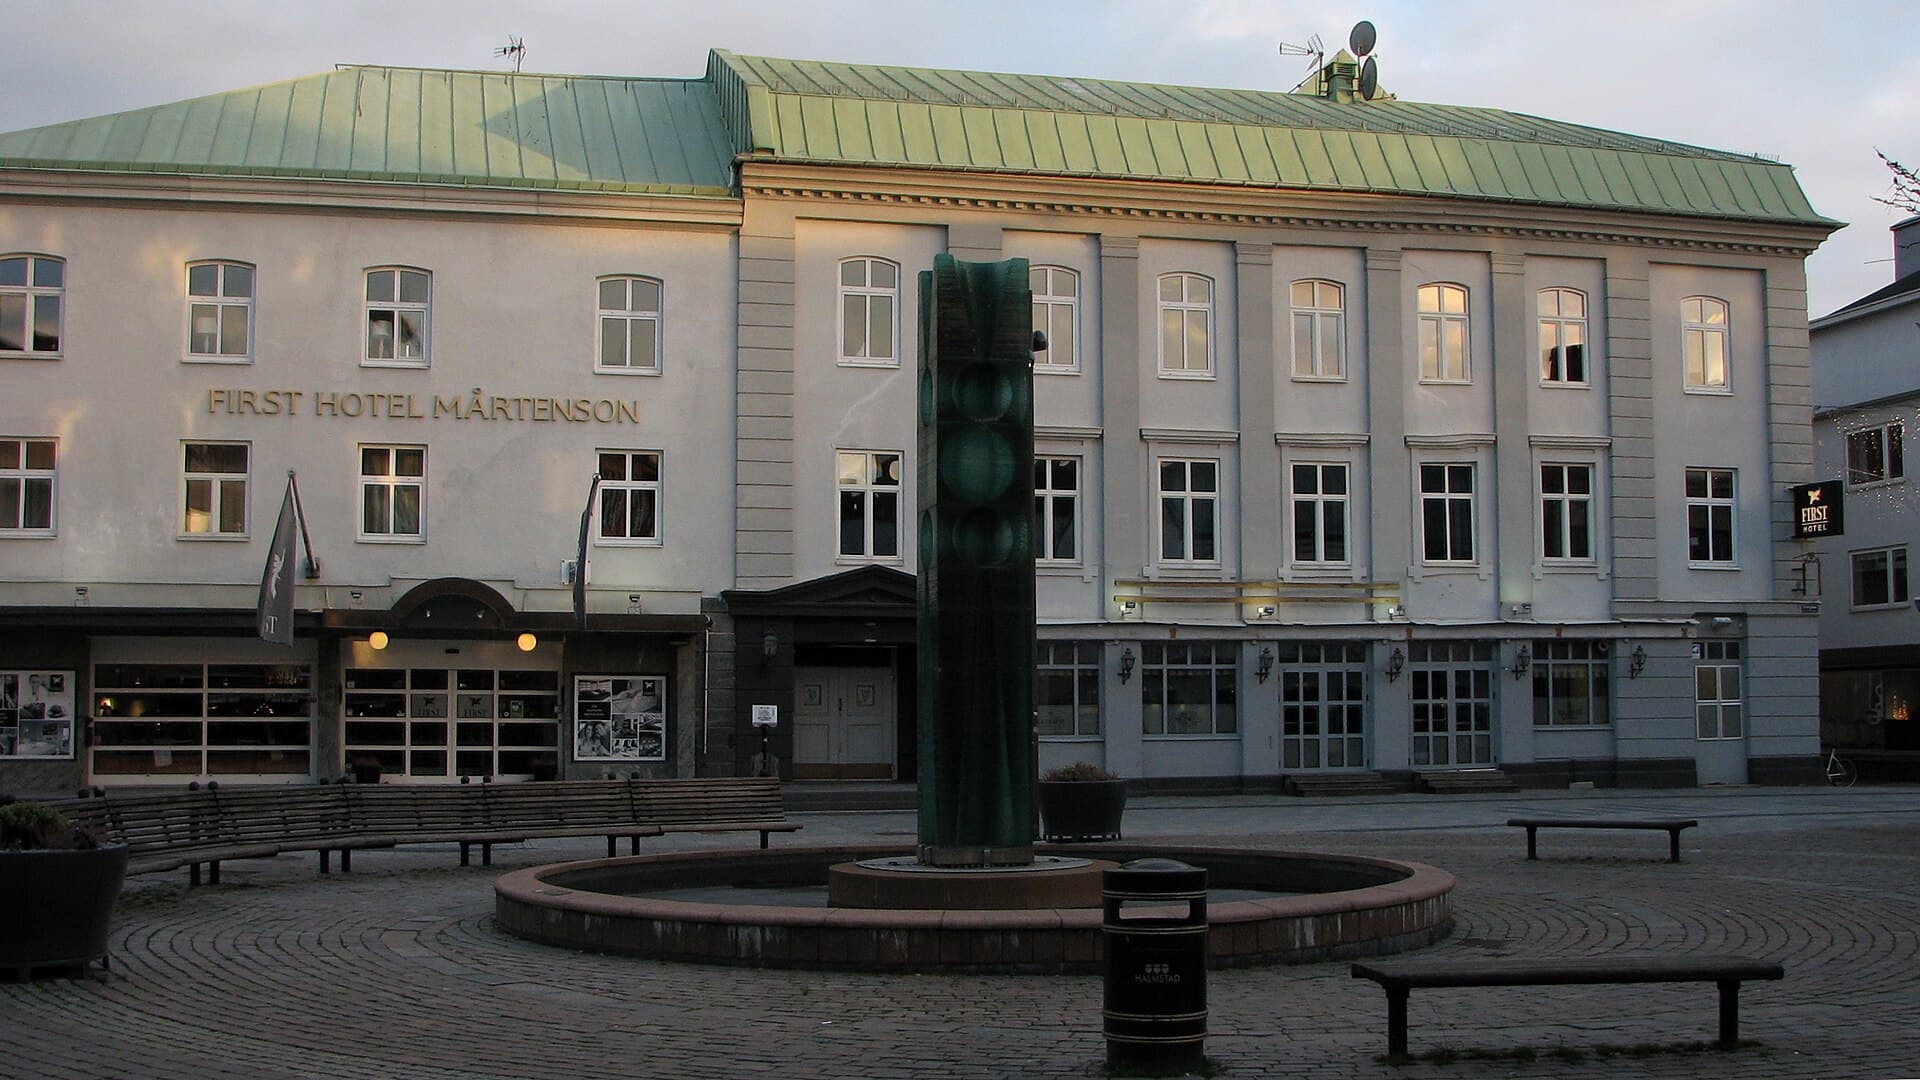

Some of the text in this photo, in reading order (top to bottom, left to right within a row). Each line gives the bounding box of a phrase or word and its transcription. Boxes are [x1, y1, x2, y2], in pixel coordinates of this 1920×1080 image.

[208, 387, 640, 424] FIRST HOTEL MÅRTENSON
[1801, 505, 1829, 522] FIRST
[1802, 524, 1828, 533] HOTEL
[1135, 973, 1181, 984] HALMSTAD
